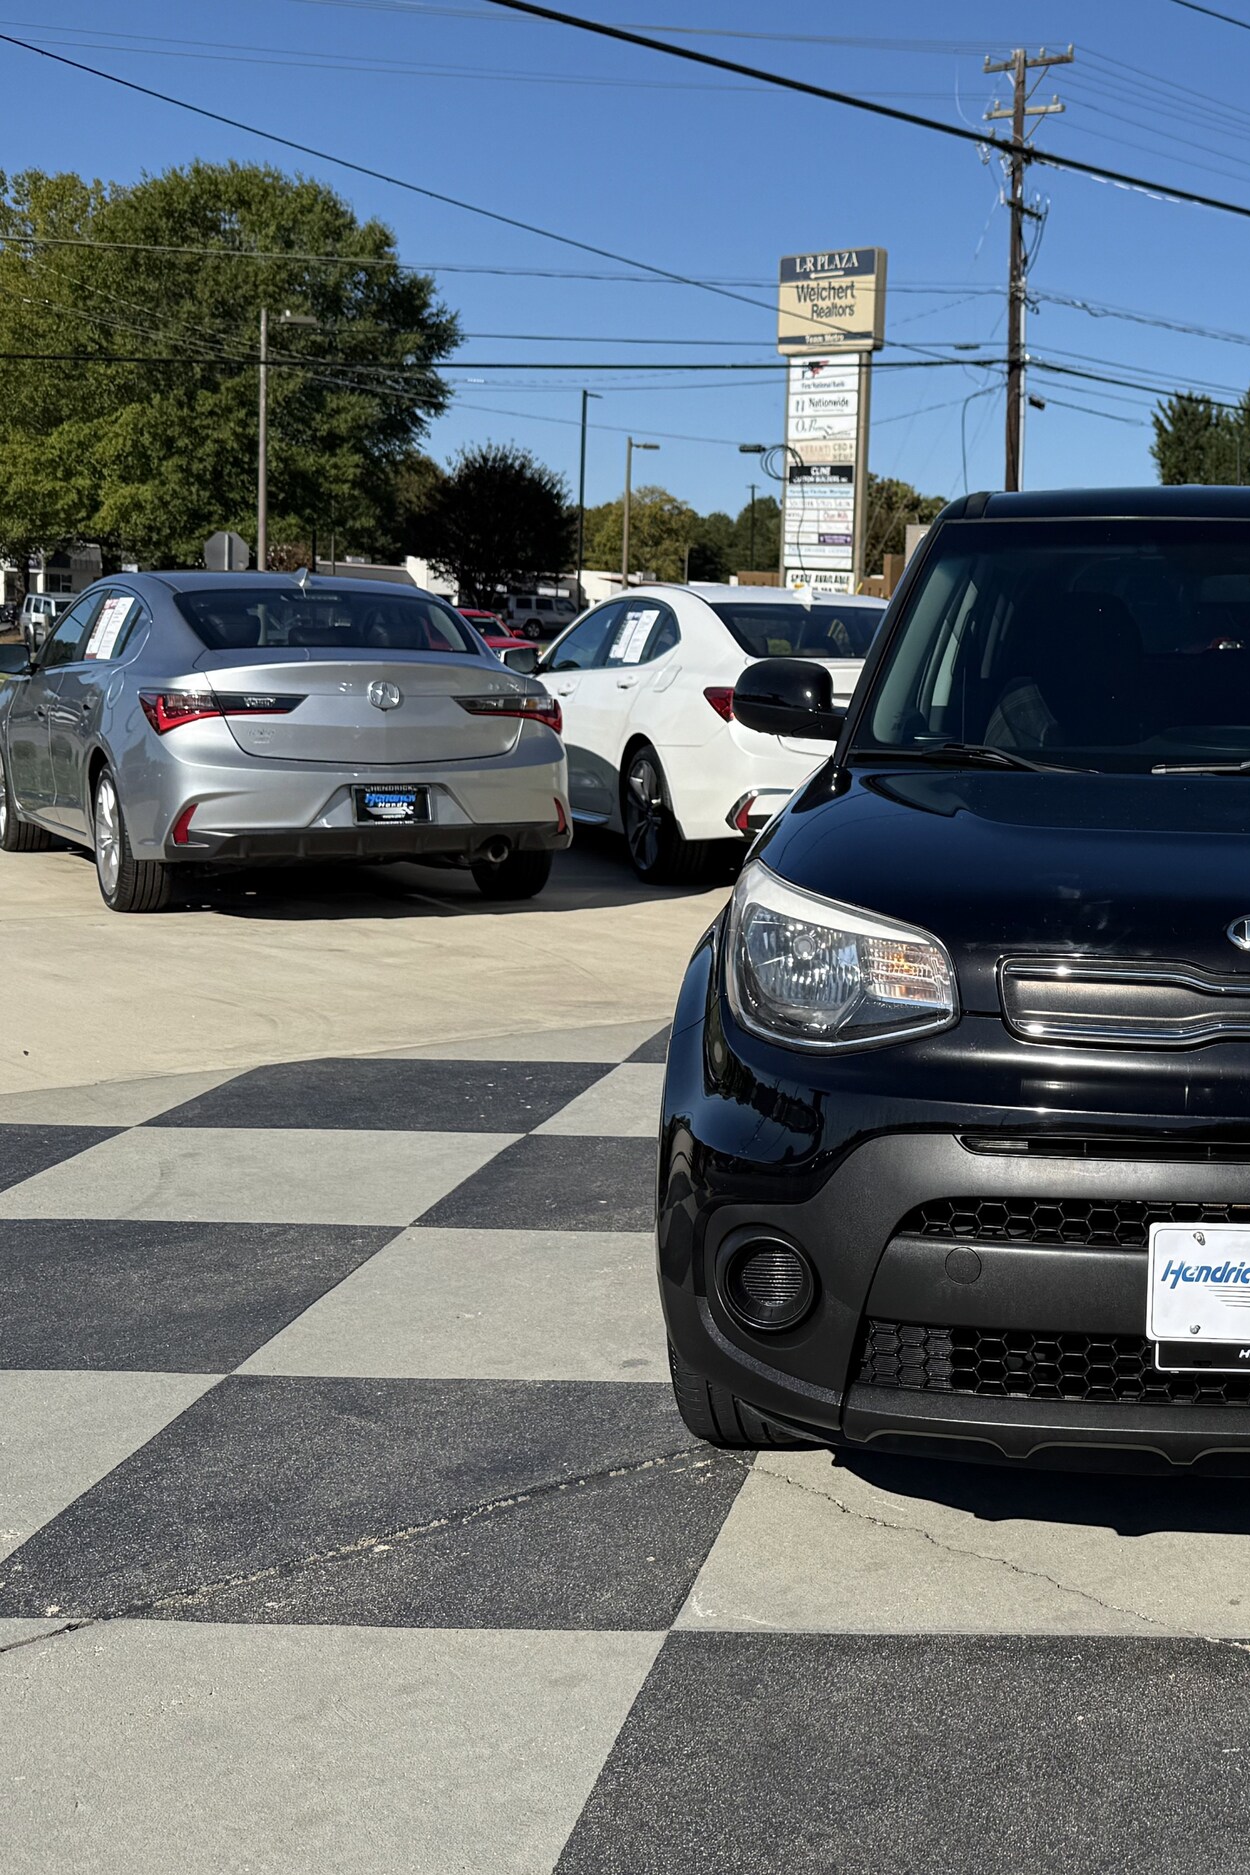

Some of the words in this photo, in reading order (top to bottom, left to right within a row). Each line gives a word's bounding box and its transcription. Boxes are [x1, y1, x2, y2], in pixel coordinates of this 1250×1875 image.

[795, 257, 815, 273] L-R
[817, 252, 859, 271] PLAZA
[796, 281, 855, 303] Weichert
[811, 302, 855, 319] Realtors
[809, 397, 849, 408] Nationwide
